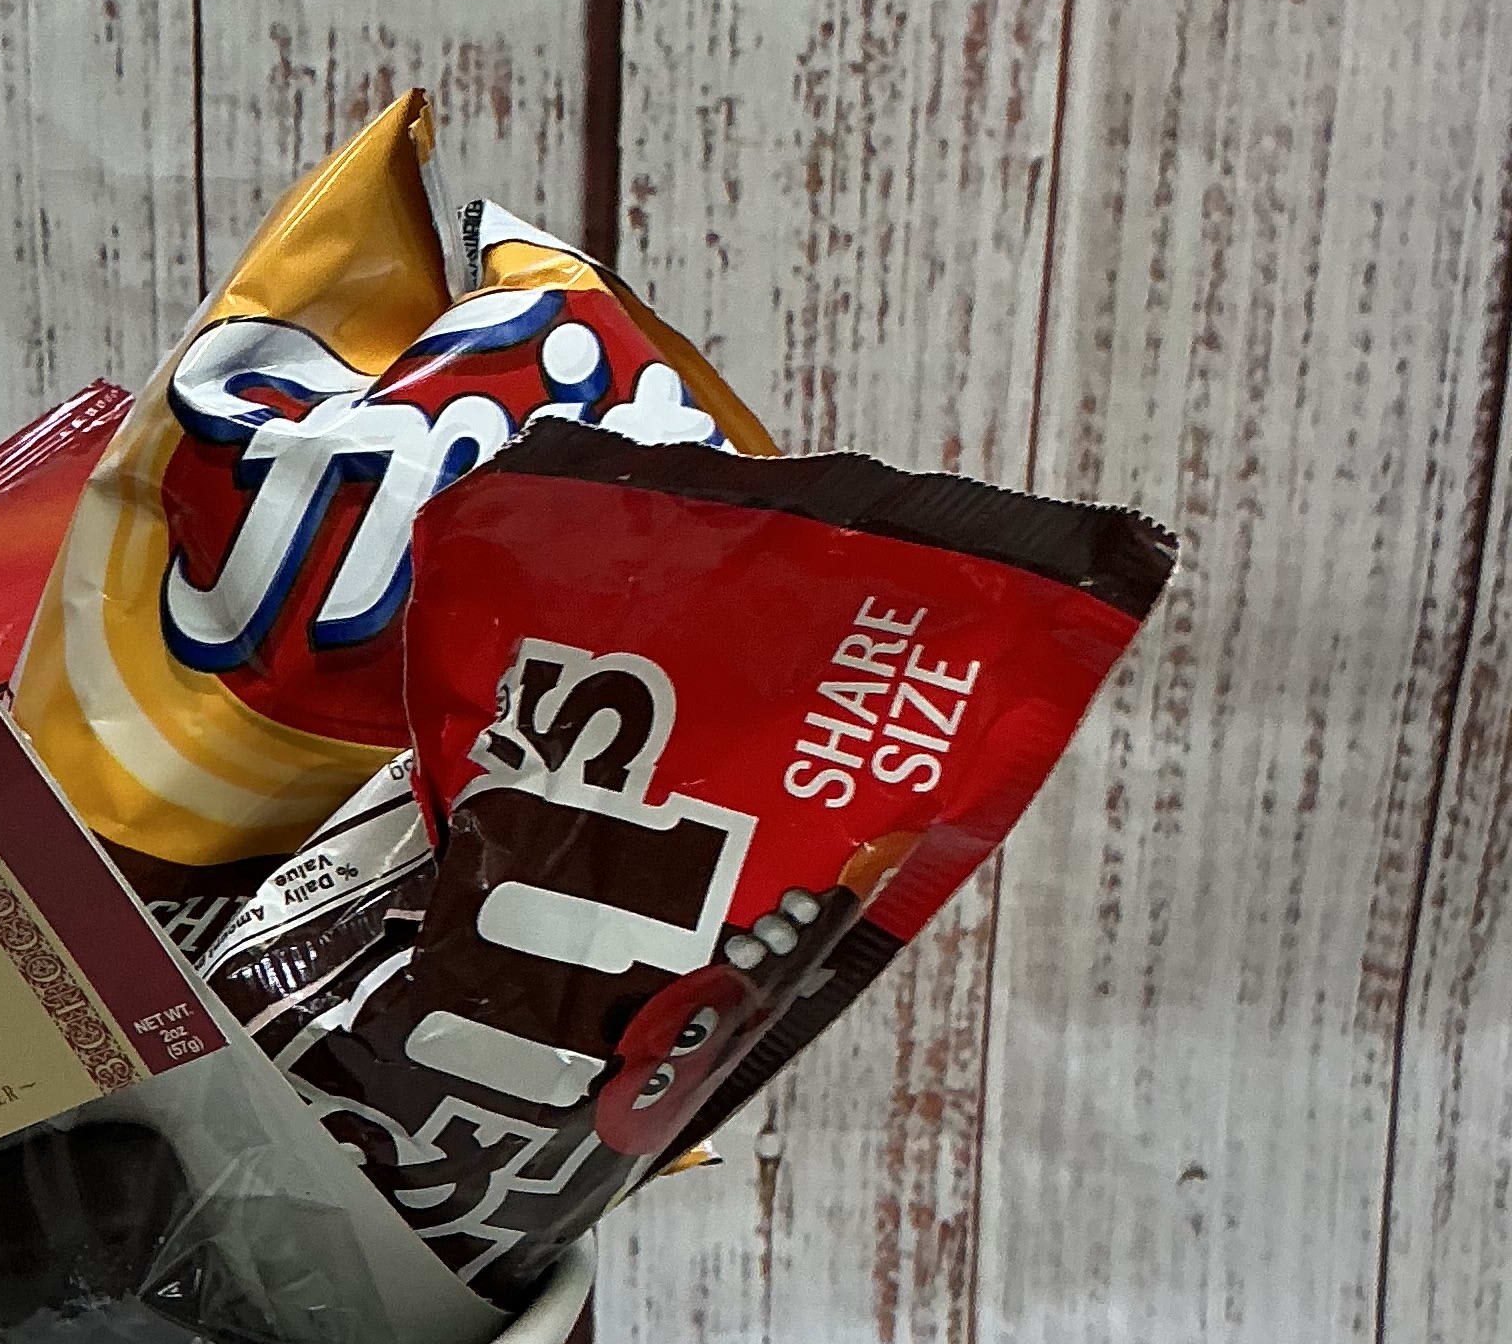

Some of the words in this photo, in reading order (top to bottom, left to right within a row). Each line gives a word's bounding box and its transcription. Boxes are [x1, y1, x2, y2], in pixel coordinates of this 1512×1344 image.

[784, 596, 929, 808] SHARE
[871, 643, 981, 793] SIZE
[274, 854, 335, 888] Value
[336, 862, 358, 881] %
[284, 873, 335, 906] Daily
[133, 1012, 165, 1034] NET
[163, 1002, 194, 1023] WT.
[159, 1025, 189, 1043] 2oz
[166, 1035, 205, 1061] (57g)
